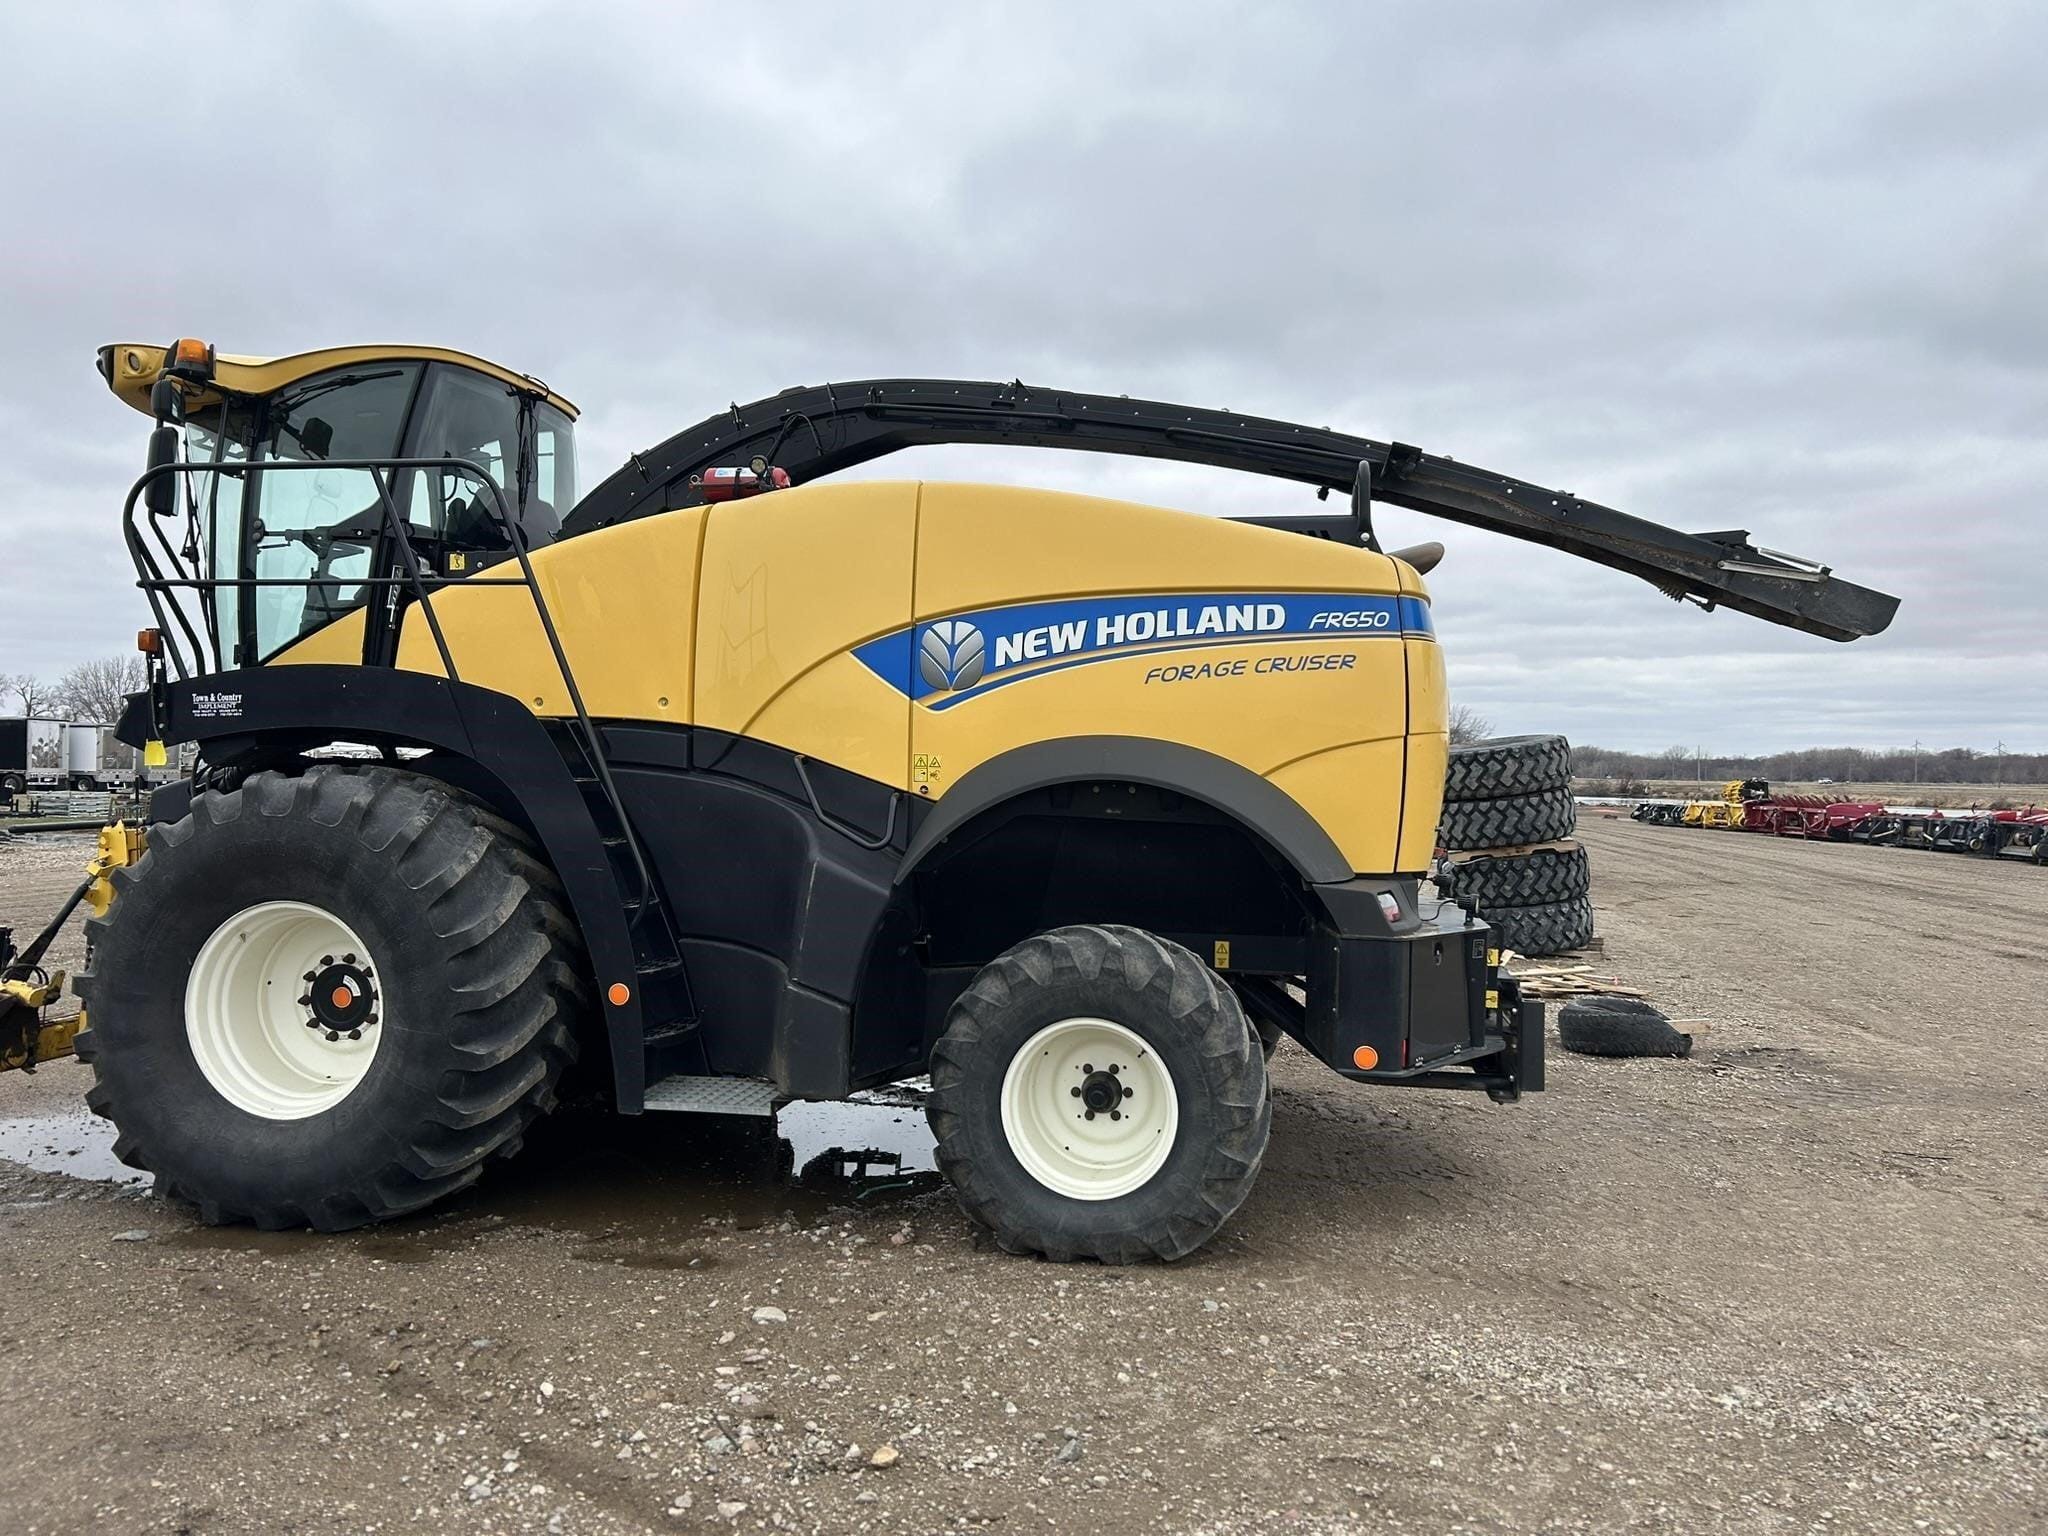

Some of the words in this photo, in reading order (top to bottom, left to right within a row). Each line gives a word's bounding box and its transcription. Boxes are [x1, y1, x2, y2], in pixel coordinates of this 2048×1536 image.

[1308, 611, 1390, 629] FR650
[994, 620, 1088, 667] NEW
[1096, 604, 1286, 646] HOLLAND
[1144, 659, 1249, 685] FORAGE
[1254, 654, 1357, 674] CRUISER
[192, 693, 209, 703] Town
[210, 693, 216, 702] &
[217, 692, 242, 704] Country
